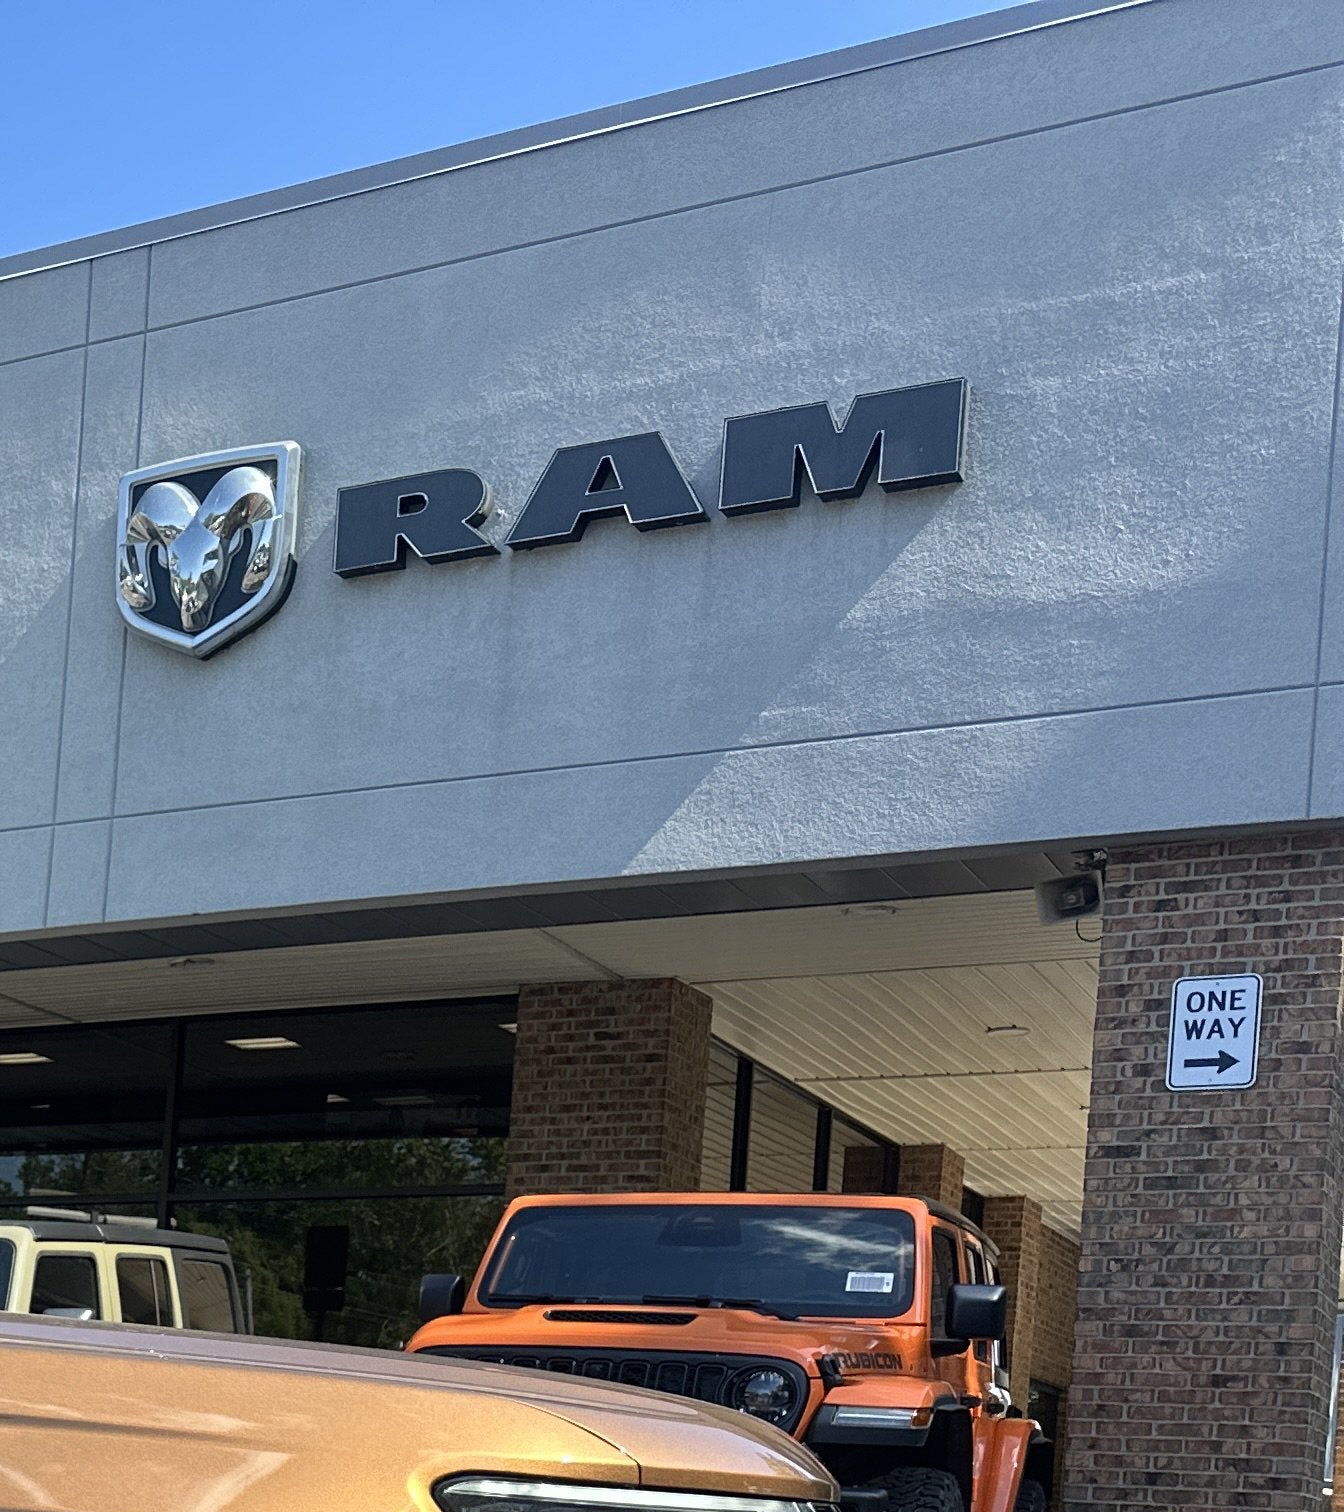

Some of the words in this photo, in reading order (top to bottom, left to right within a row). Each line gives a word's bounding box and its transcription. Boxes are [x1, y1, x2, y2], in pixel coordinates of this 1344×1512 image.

[332, 376, 971, 579] RAM
[1186, 989, 1247, 1013] ONE
[1183, 1016, 1247, 1041] WAY
[833, 1351, 903, 1370] RUBICON
